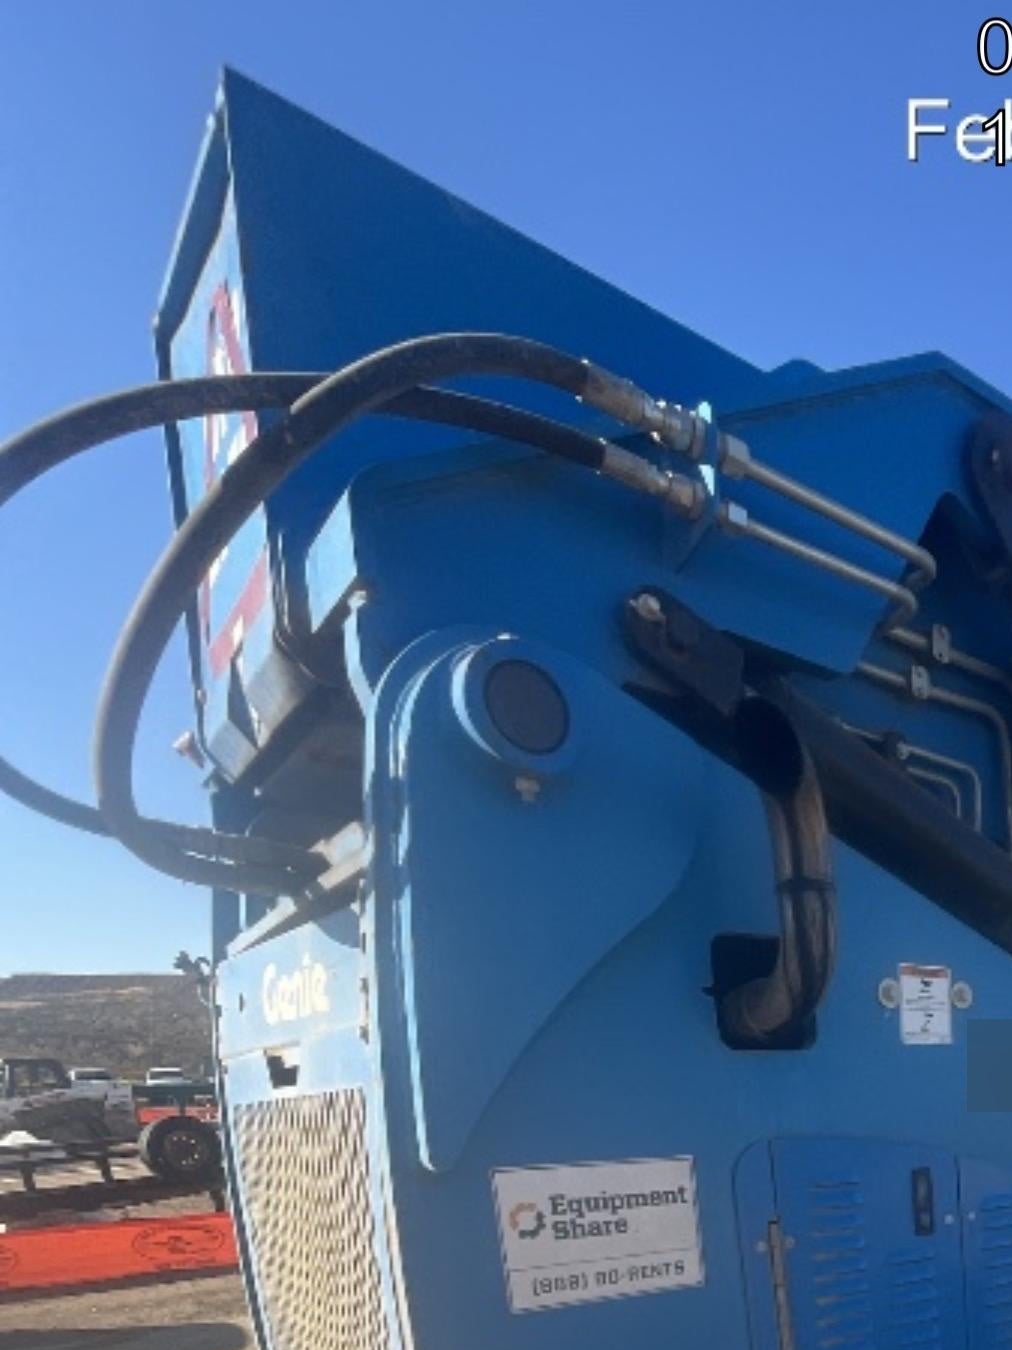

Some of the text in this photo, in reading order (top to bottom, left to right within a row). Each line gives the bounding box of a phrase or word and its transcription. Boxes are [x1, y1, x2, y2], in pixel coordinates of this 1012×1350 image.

[262, 953, 331, 1026] Genie
[548, 1185, 688, 1219] Equipment
[552, 1216, 628, 1240] Share
